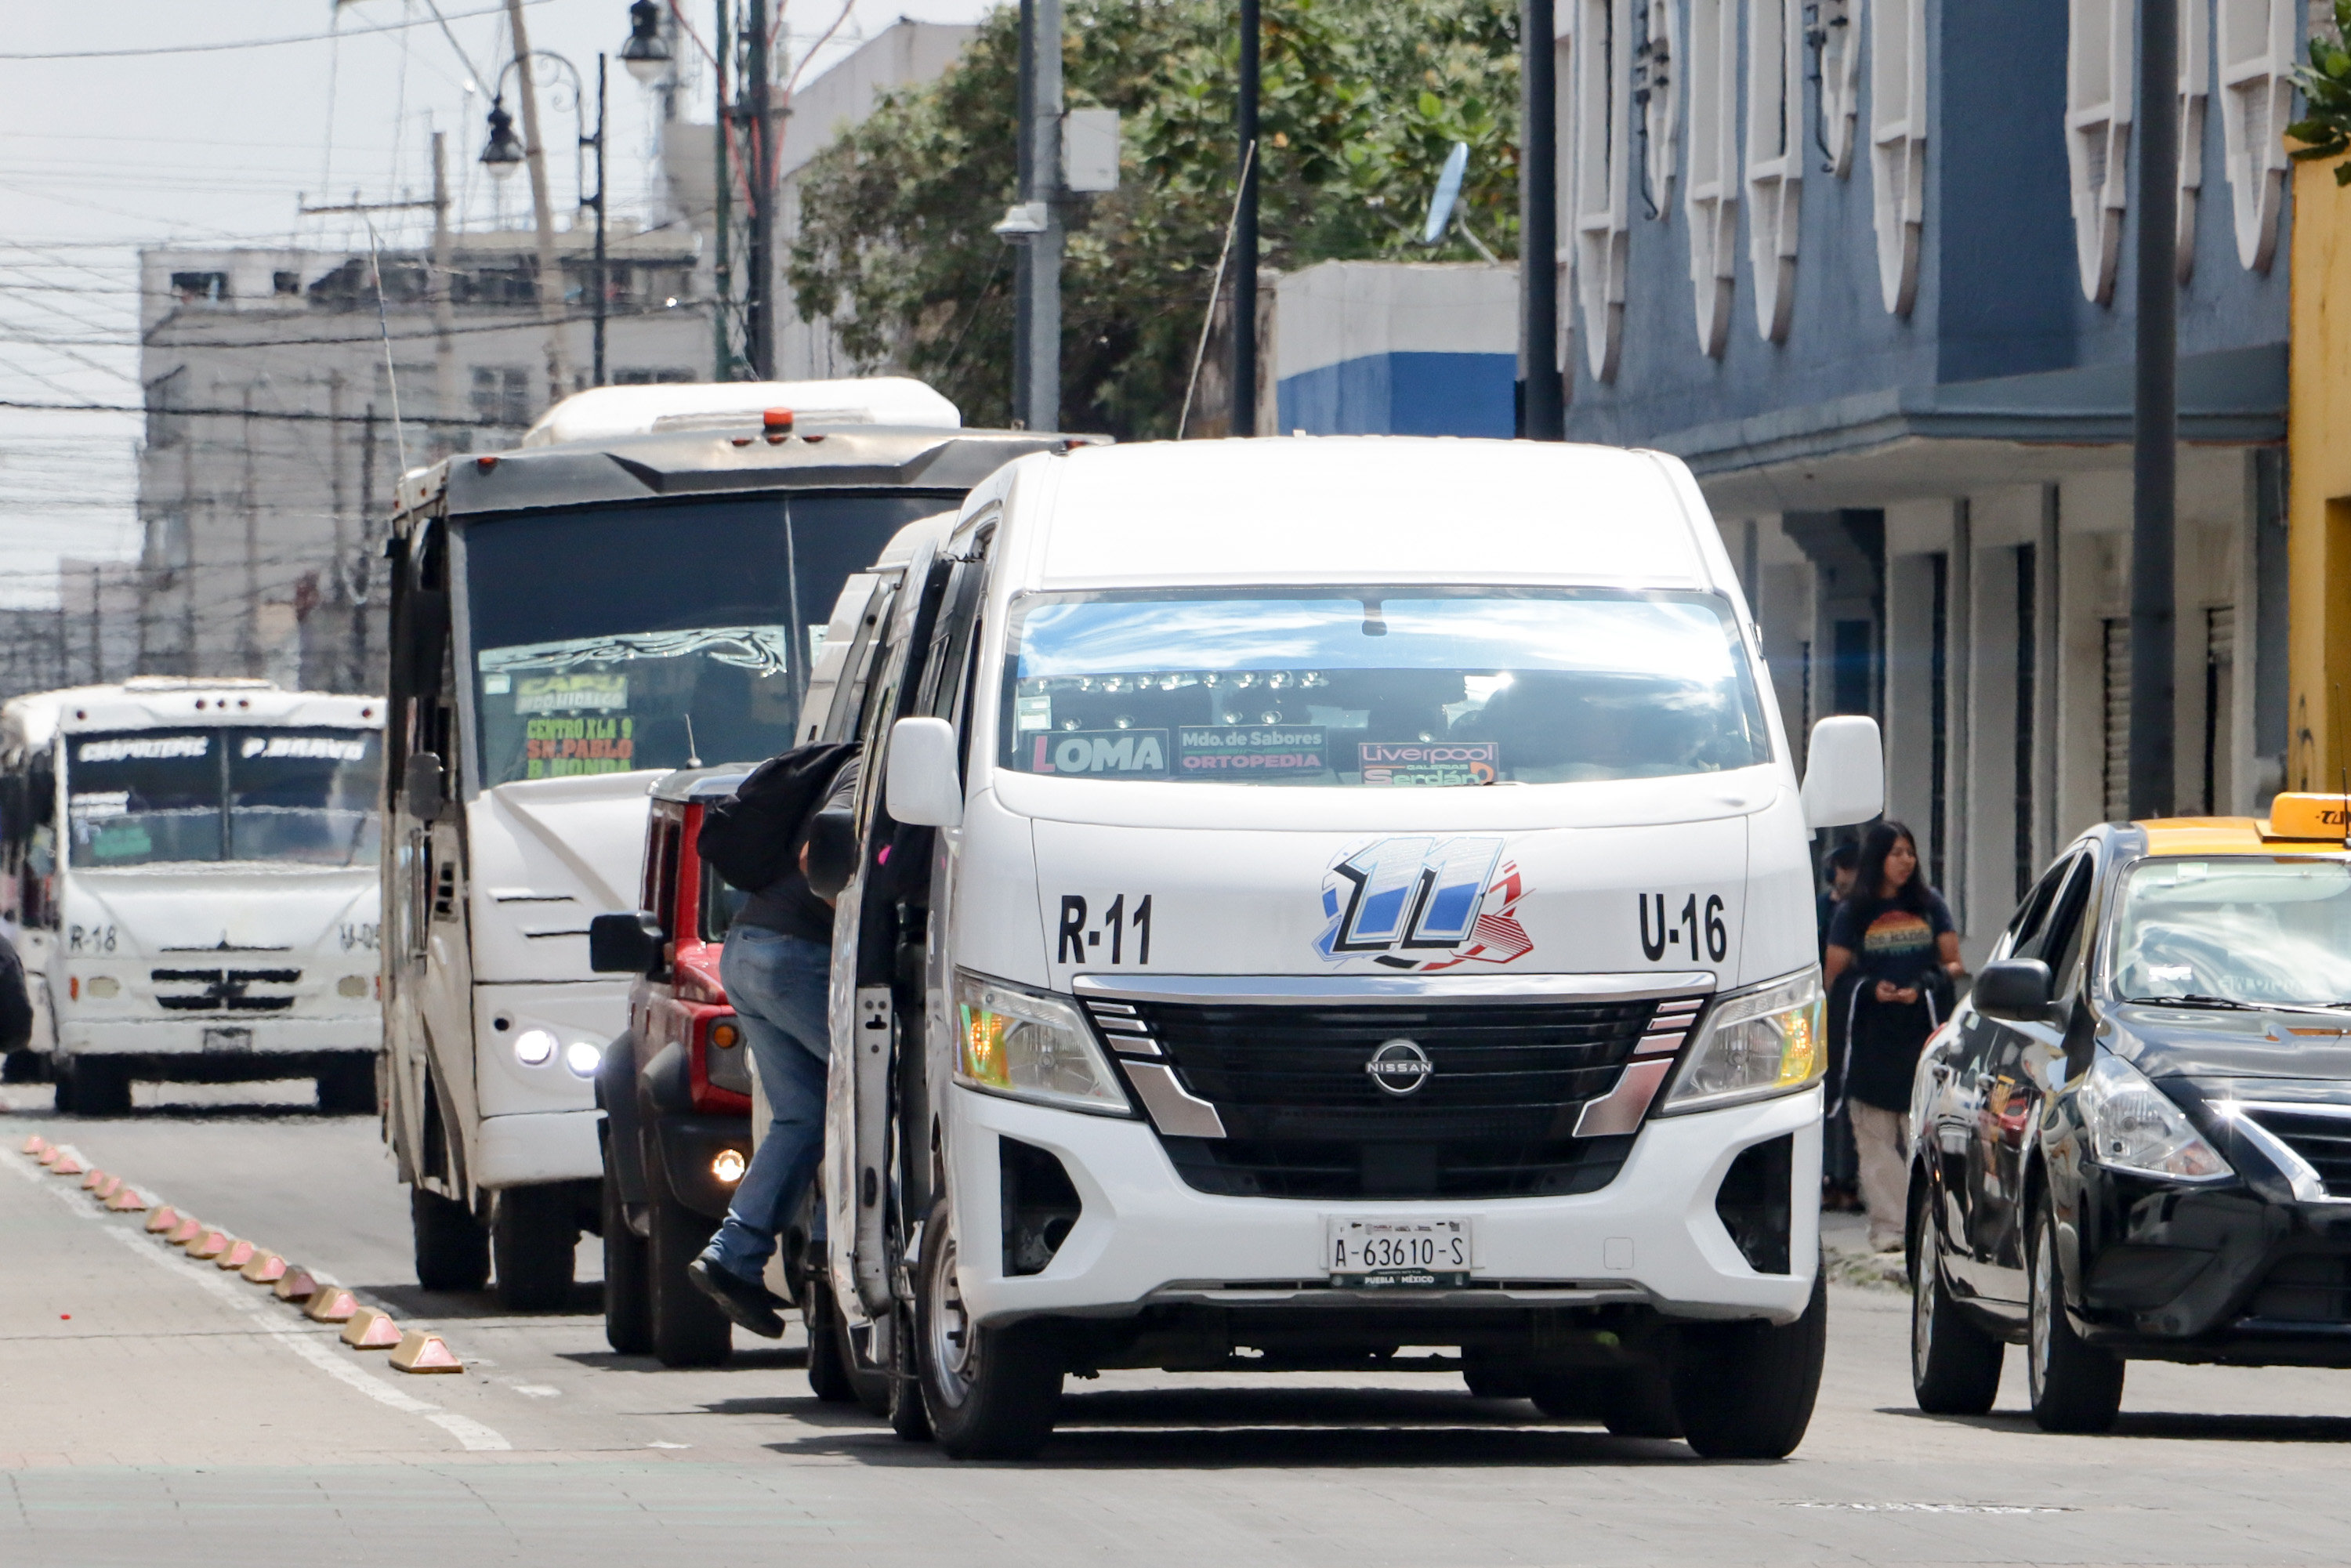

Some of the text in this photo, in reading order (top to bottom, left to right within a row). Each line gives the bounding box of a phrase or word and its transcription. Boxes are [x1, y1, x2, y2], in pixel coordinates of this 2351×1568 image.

[527, 719, 584, 739] CENTRO
[1182, 731, 1322, 747] Mdo. de Sabores
[1032, 735, 1165, 773] LOMA
[1182, 755, 1322, 769] ORTOPEDIA
[1362, 744, 1493, 764] Liverpool
[1364, 769, 1480, 784] Serdán
[70, 925, 118, 951] R-18
[1058, 893, 1152, 965] R-11
[1639, 893, 1727, 963] U-16
[1367, 1063, 1433, 1073] NISSAN
[1335, 1237, 1464, 1267] A-63610-S
[1364, 1273, 1435, 1284] PUEBLA MÉXICO
